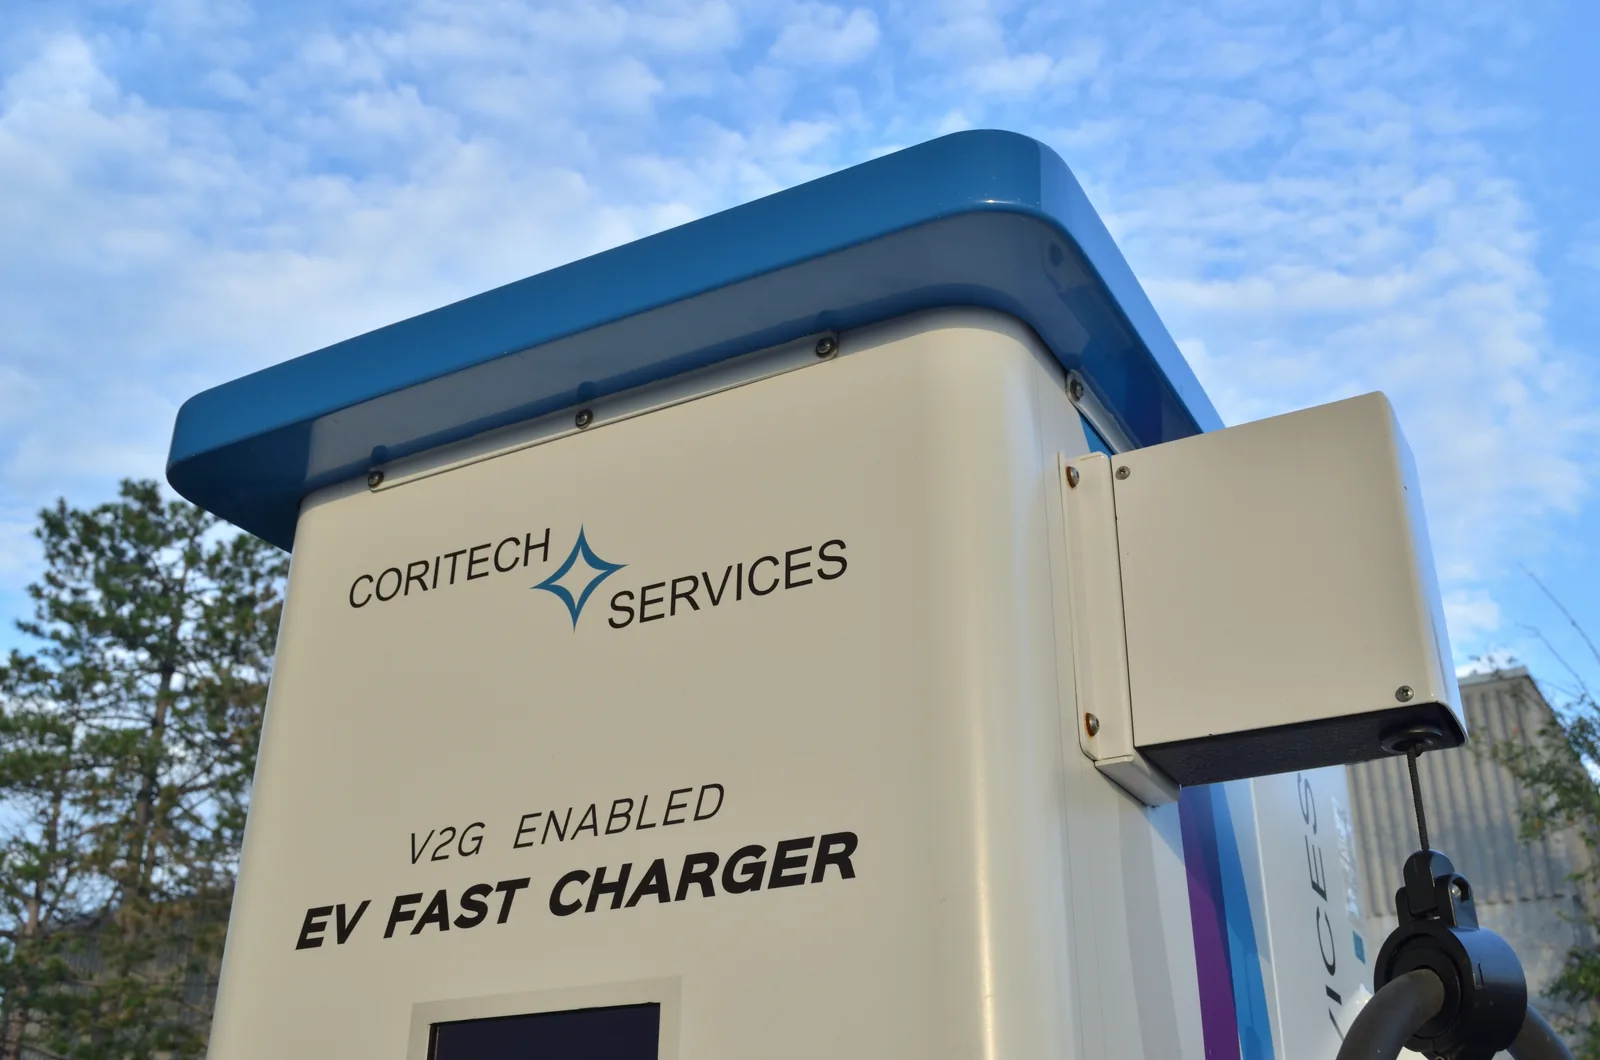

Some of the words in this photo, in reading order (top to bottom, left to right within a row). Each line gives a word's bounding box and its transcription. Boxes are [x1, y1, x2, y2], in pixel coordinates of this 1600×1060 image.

[349, 528, 550, 608] CORITECH
[608, 540, 848, 629] SERVICES
[411, 822, 485, 864] V2G
[513, 783, 725, 849] ENABLED
[295, 900, 371, 950] EV
[383, 878, 530, 938] FAST
[548, 832, 859, 916] CHARGER
